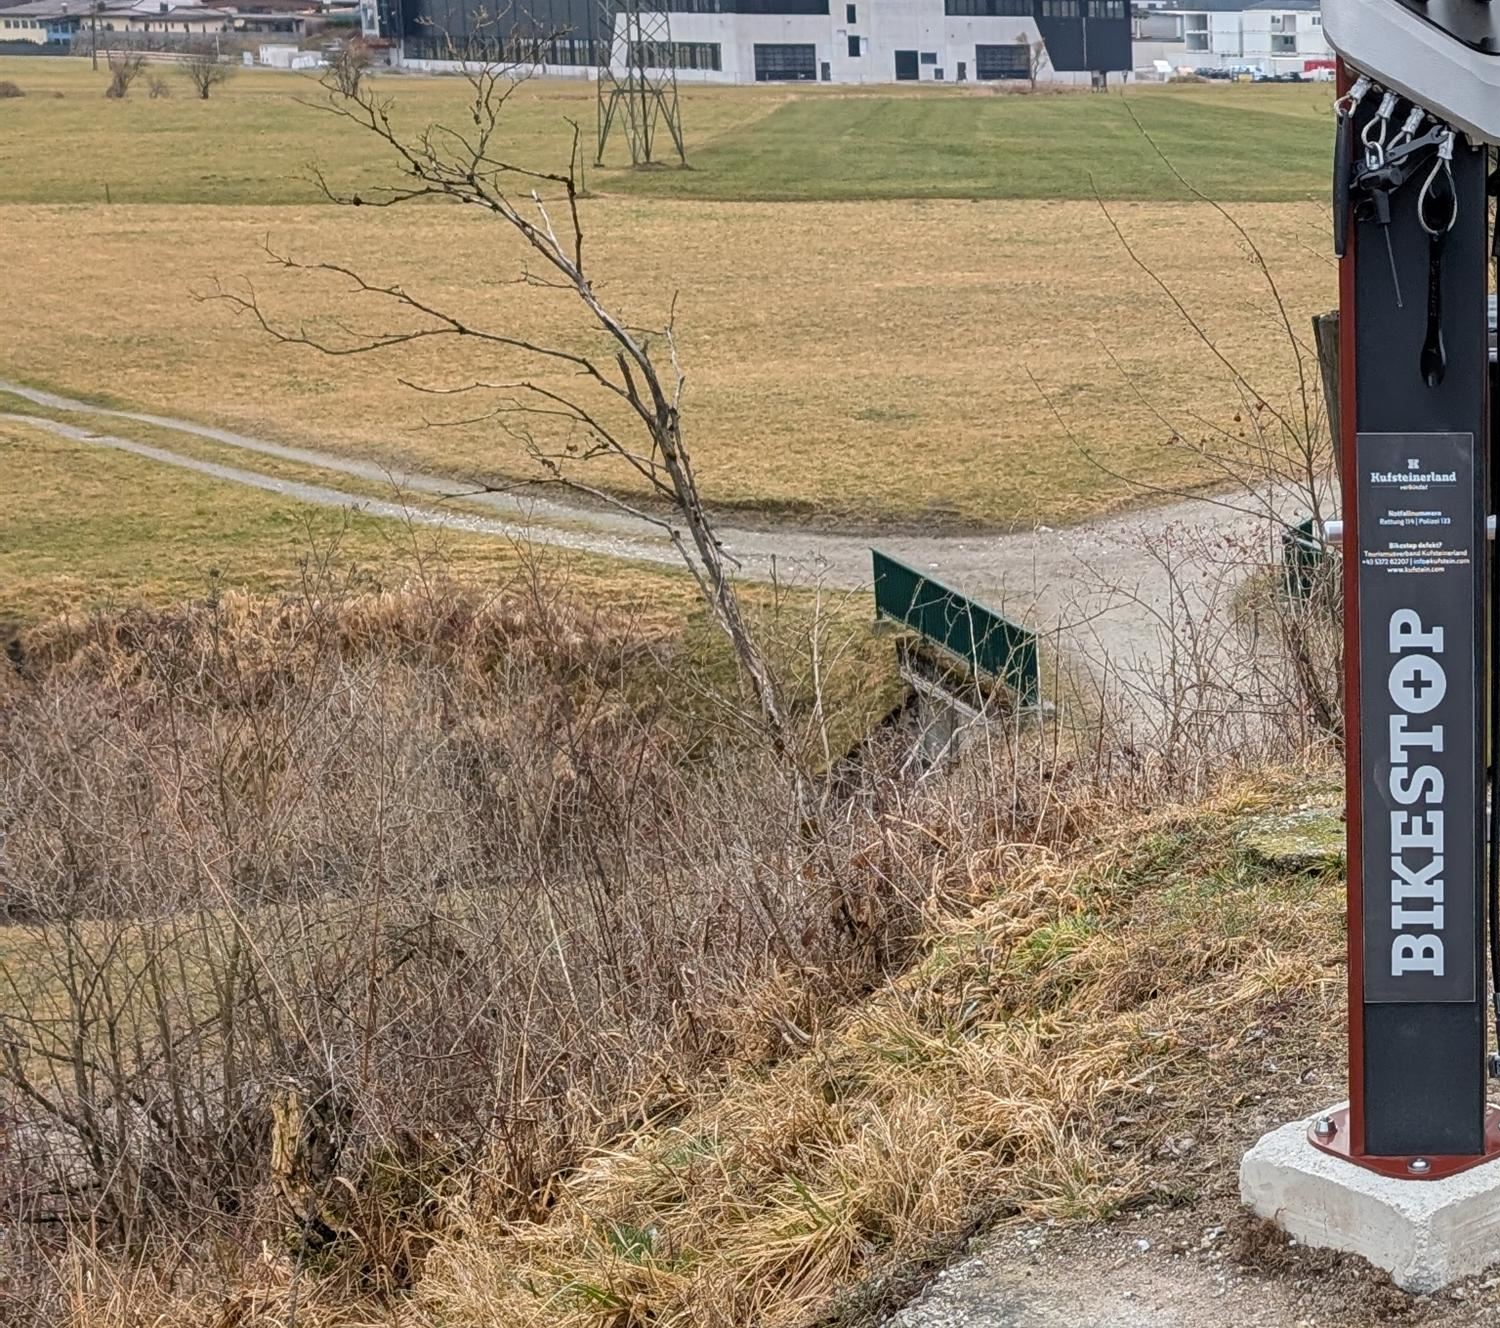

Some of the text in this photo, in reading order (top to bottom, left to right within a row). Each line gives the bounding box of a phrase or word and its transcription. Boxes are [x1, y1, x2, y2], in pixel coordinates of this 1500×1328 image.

[1370, 471, 1457, 483] Kufsteinerland
[1379, 518, 1405, 526] Rettung
[1388, 541, 1443, 550] Bikestop defekt?
[1421, 549, 1468, 557] Kufsteinerland
